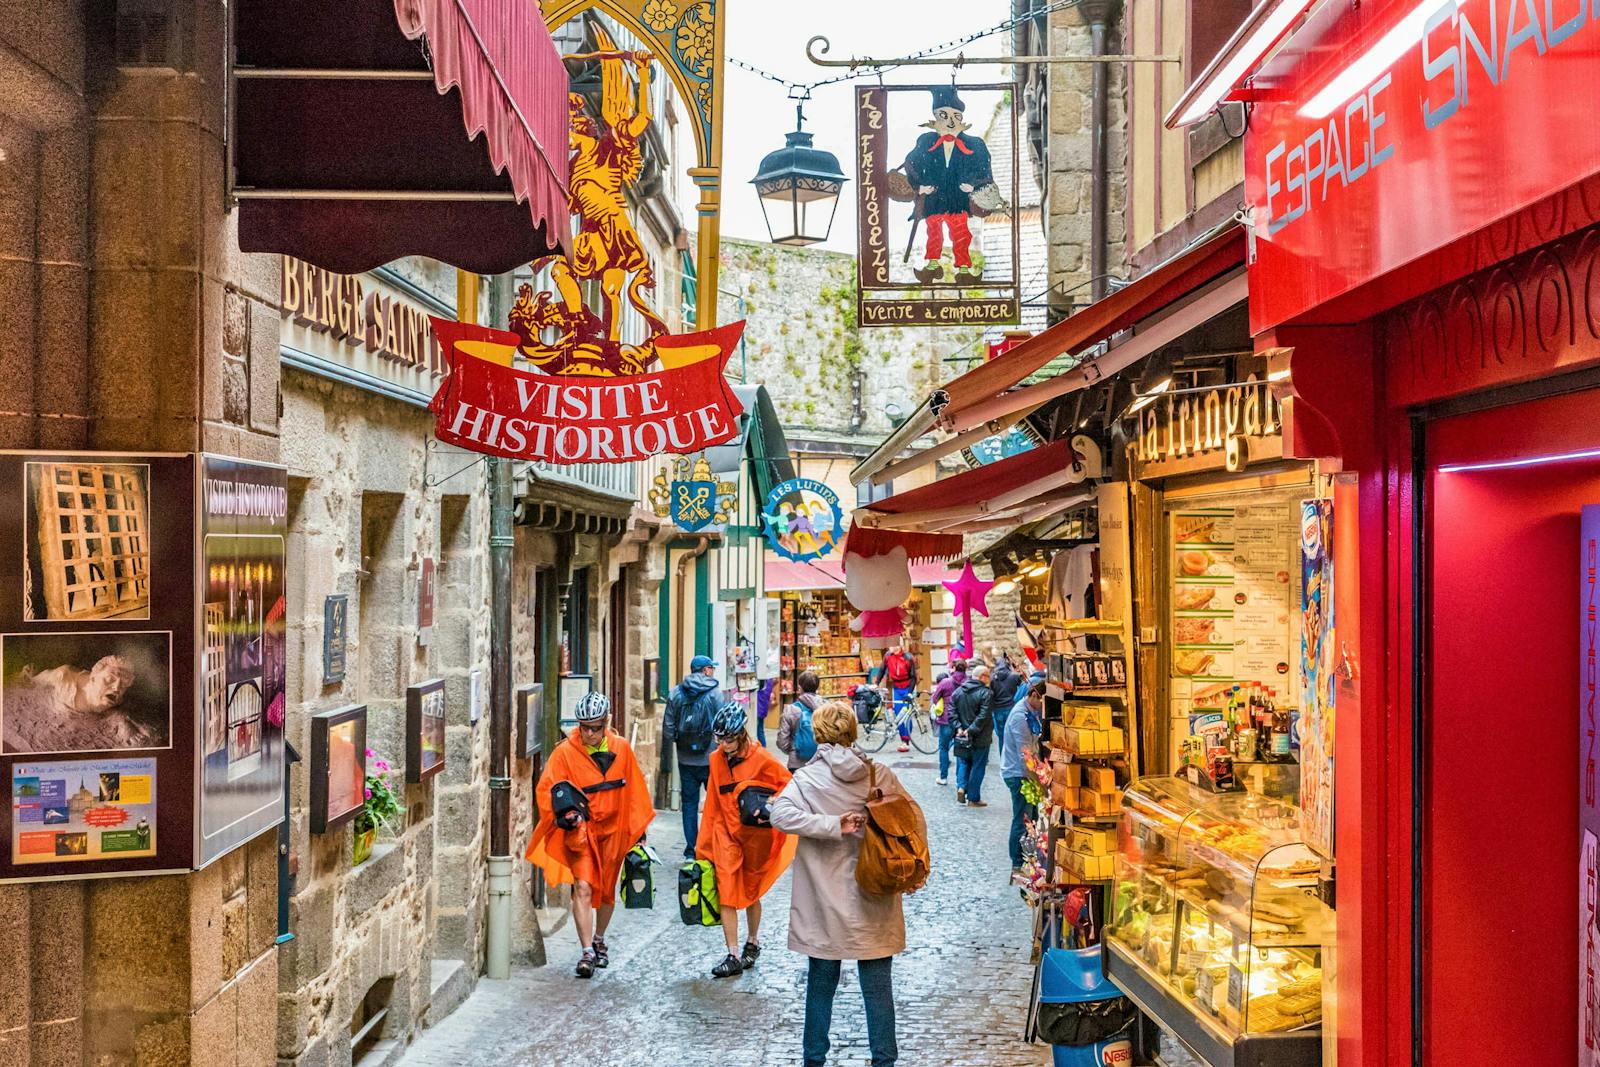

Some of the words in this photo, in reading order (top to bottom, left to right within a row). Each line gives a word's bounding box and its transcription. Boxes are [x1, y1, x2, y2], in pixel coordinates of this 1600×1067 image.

[1265, 72, 1395, 236] ESPACE
[514, 377, 669, 421] VISITE
[446, 401, 730, 461] HISTORIQUE
[203, 478, 233, 515] VISITE
[235, 481, 285, 526] HISTORIQUE
[771, 483, 792, 502] LES
[1025, 584, 1039, 596] La
